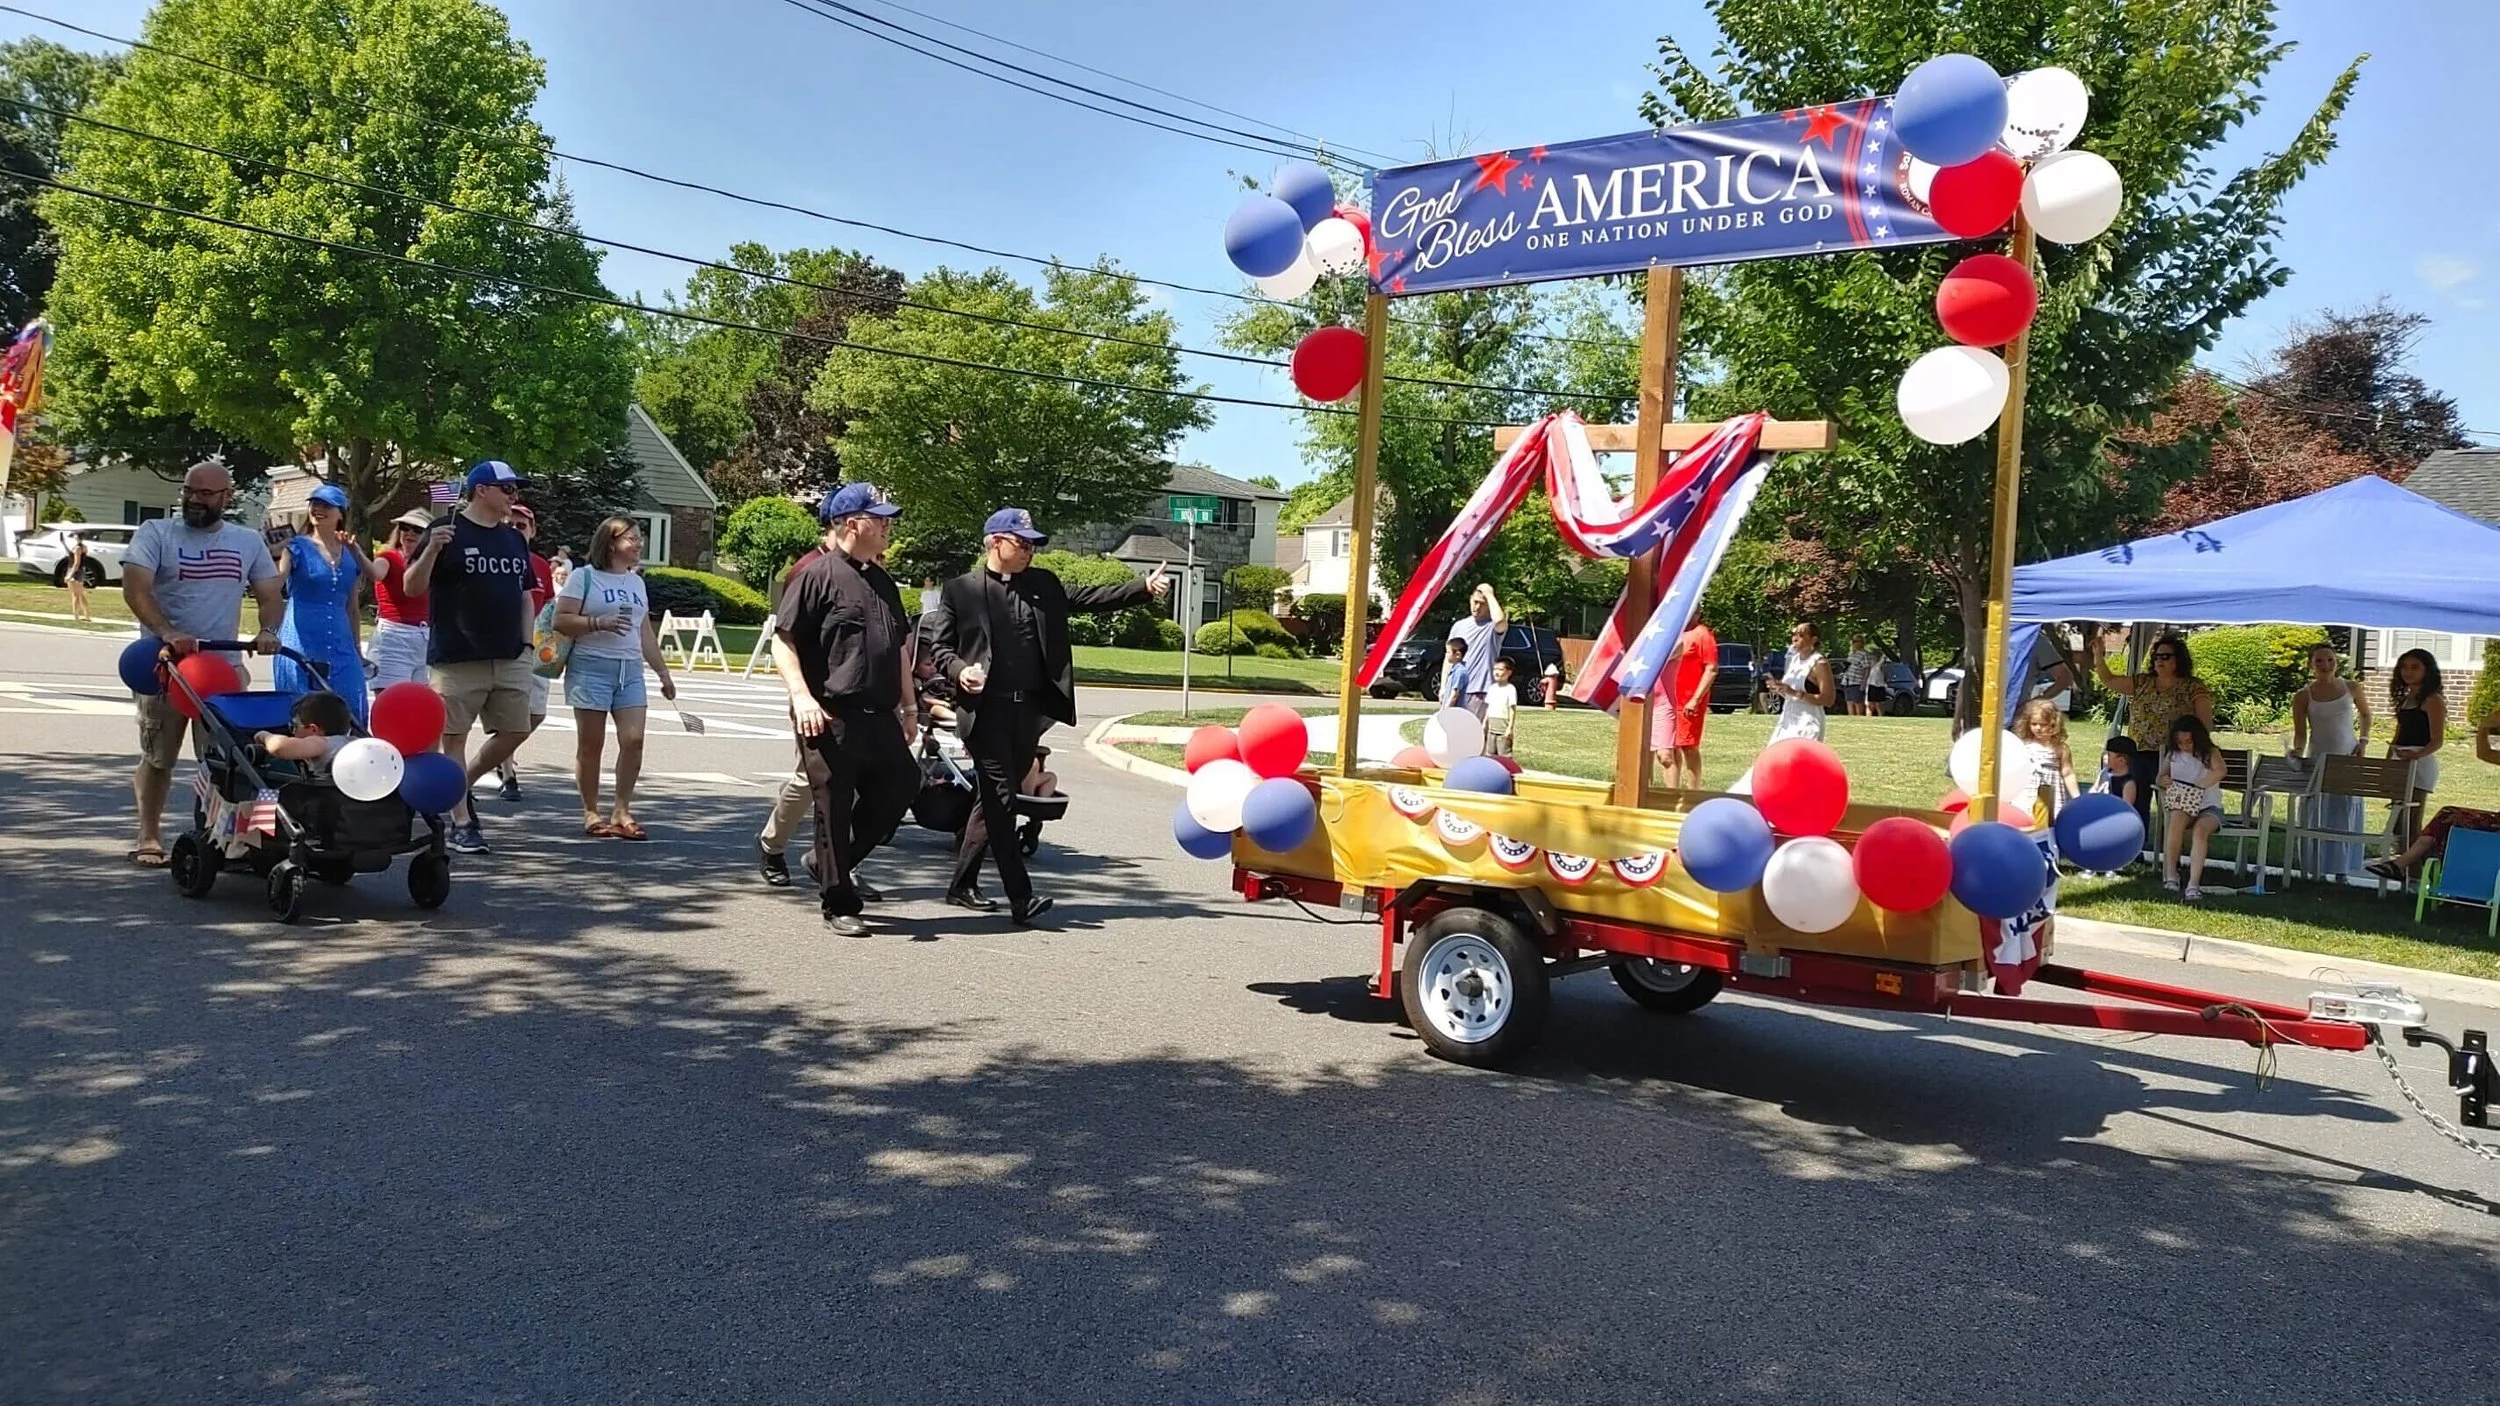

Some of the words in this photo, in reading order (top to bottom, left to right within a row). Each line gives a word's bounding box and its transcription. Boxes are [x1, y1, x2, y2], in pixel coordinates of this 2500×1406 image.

[1380, 178, 1463, 239] God
[1526, 144, 1836, 231] AMERICA
[1414, 210, 1522, 273] Bless
[1526, 231, 1570, 250] ONE
[1581, 220, 1669, 244] NATION
[1682, 210, 1765, 234] UNDER
[1779, 203, 1834, 225] GOD
[603, 588, 645, 608] USA
